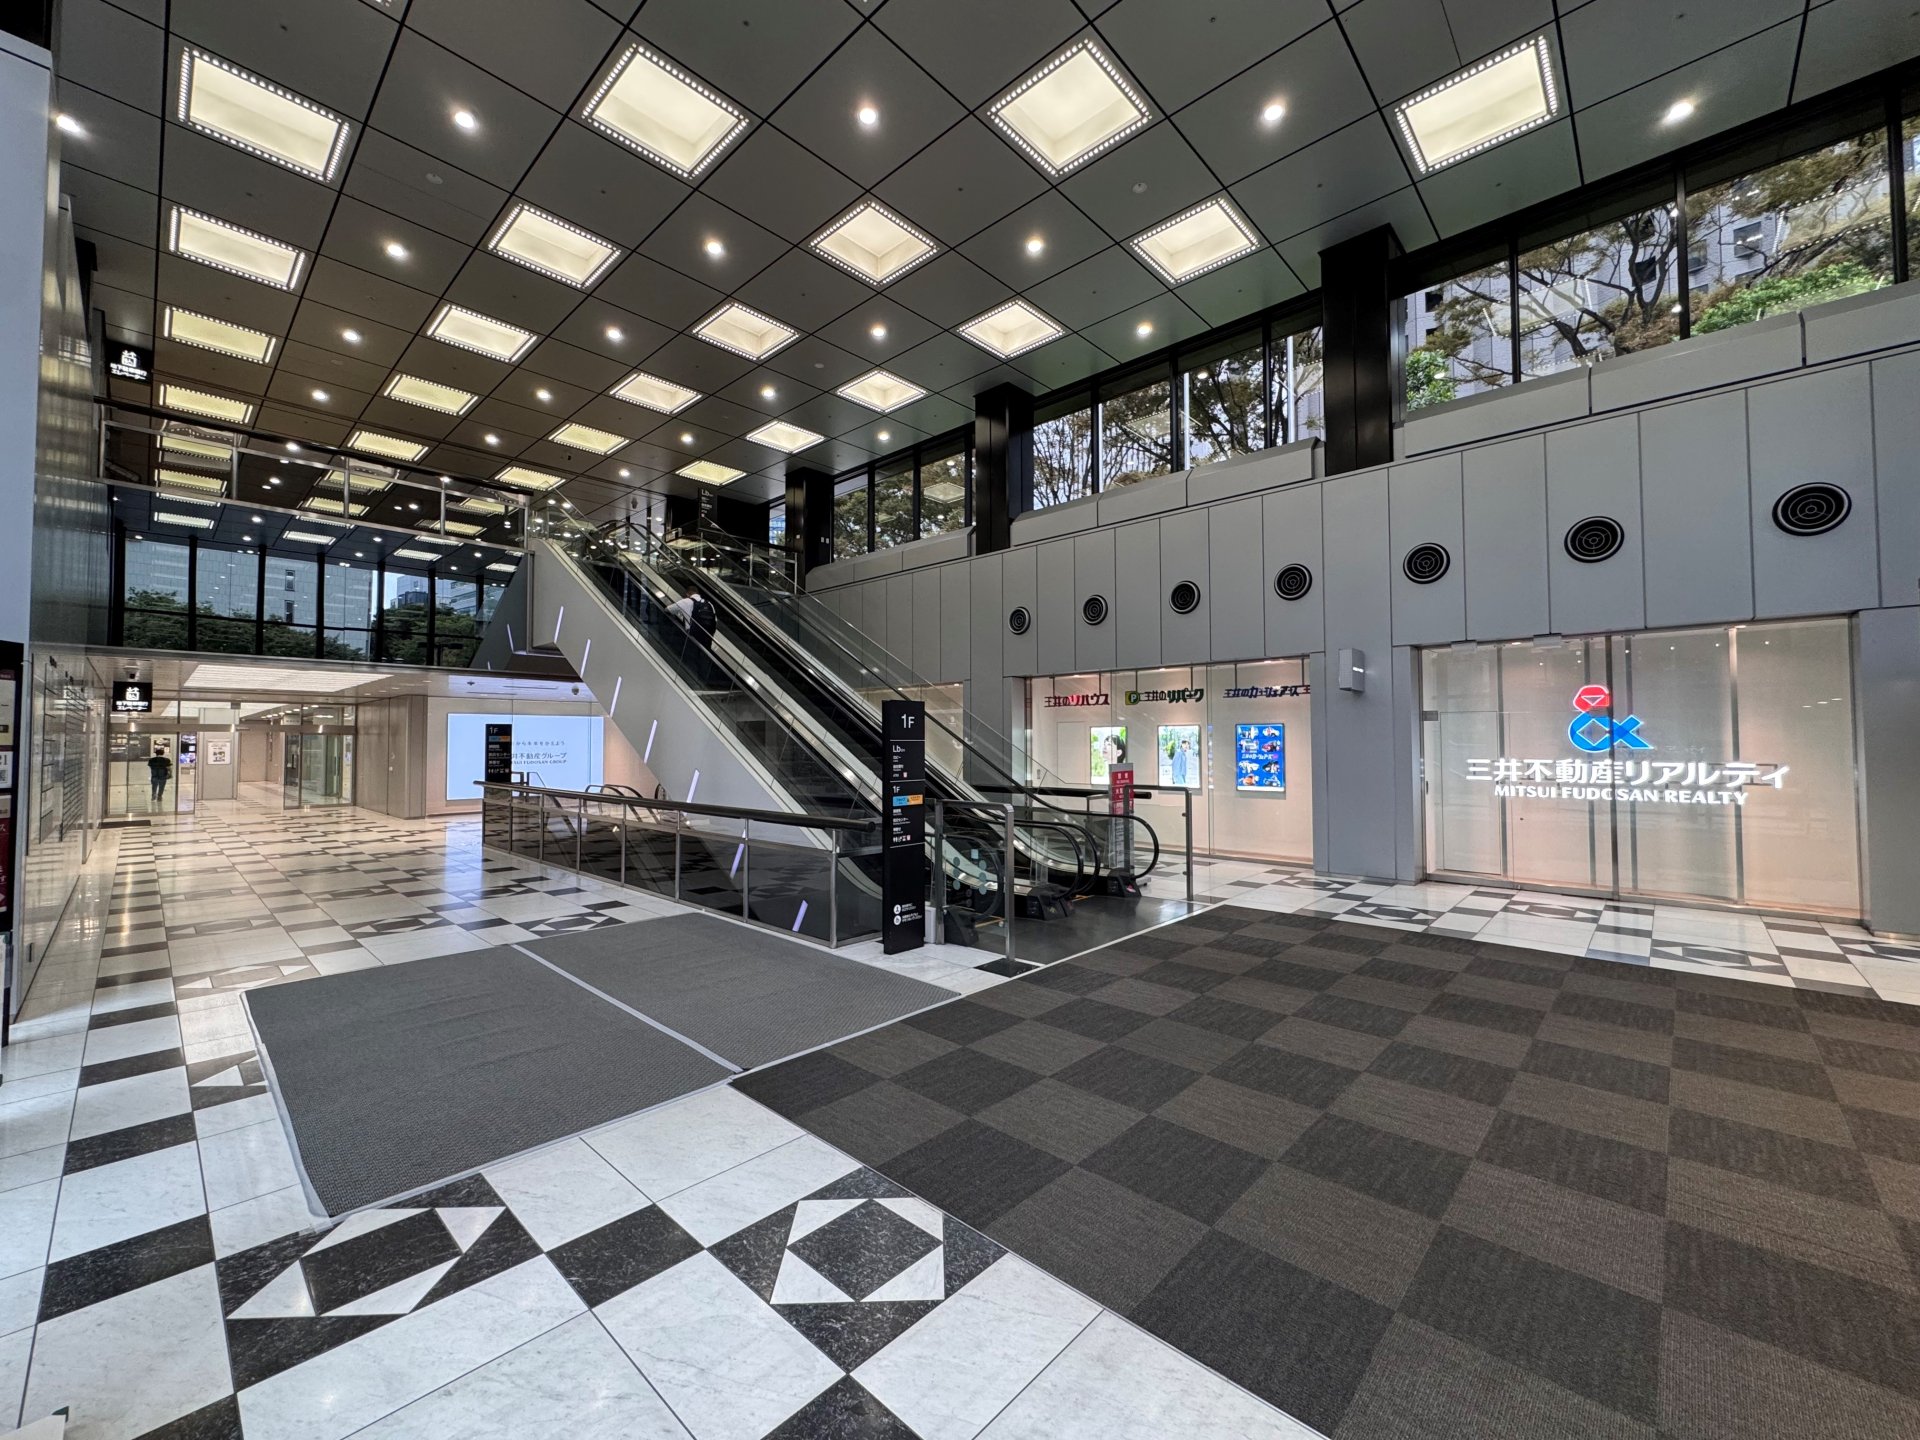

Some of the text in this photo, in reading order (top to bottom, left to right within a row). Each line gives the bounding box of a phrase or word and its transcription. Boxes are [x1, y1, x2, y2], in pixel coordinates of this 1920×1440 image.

[1044, 693, 1110, 708] 三井のリハウス
[901, 713, 915, 729] 1F
[489, 726, 499, 734] 1F
[1465, 757, 1790, 790] 三井不動産リアルティ
[893, 785, 901, 794] 1F
[1494, 784, 1749, 806] MITSUI FUDOSAN REALTY
